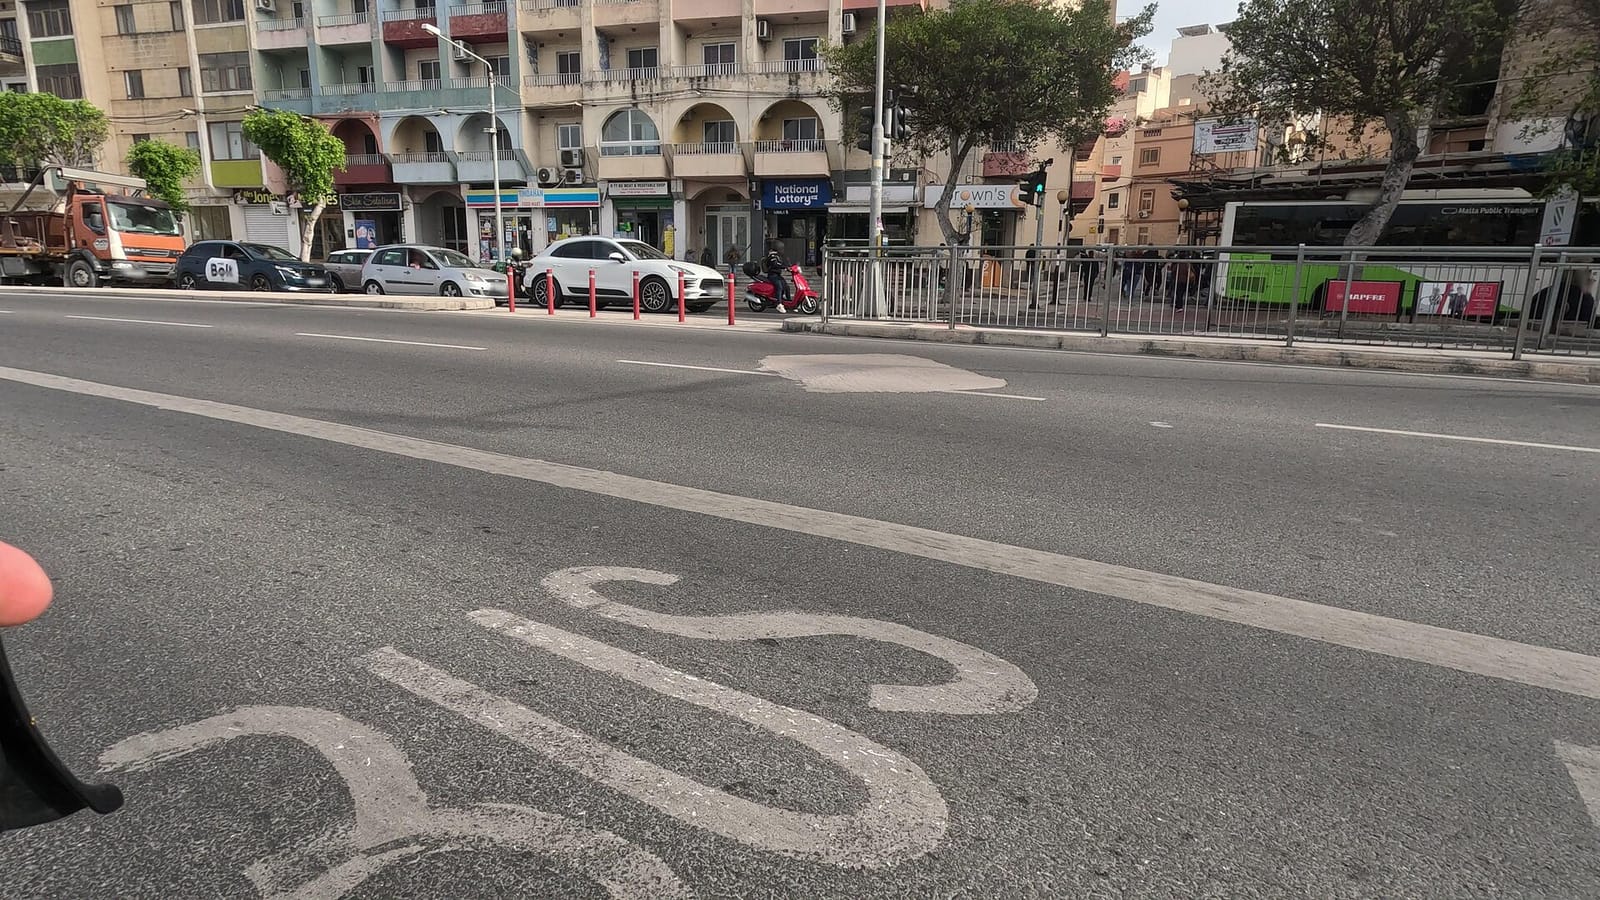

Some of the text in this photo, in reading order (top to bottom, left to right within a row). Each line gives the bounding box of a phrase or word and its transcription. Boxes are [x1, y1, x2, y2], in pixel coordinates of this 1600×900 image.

[775, 184, 818, 194] National
[954, 187, 1006, 201] rown's
[252, 191, 280, 203] Jones
[775, 194, 811, 206] Lottery
[1504, 207, 1539, 216] Transport
[210, 263, 233, 277] Bolt
